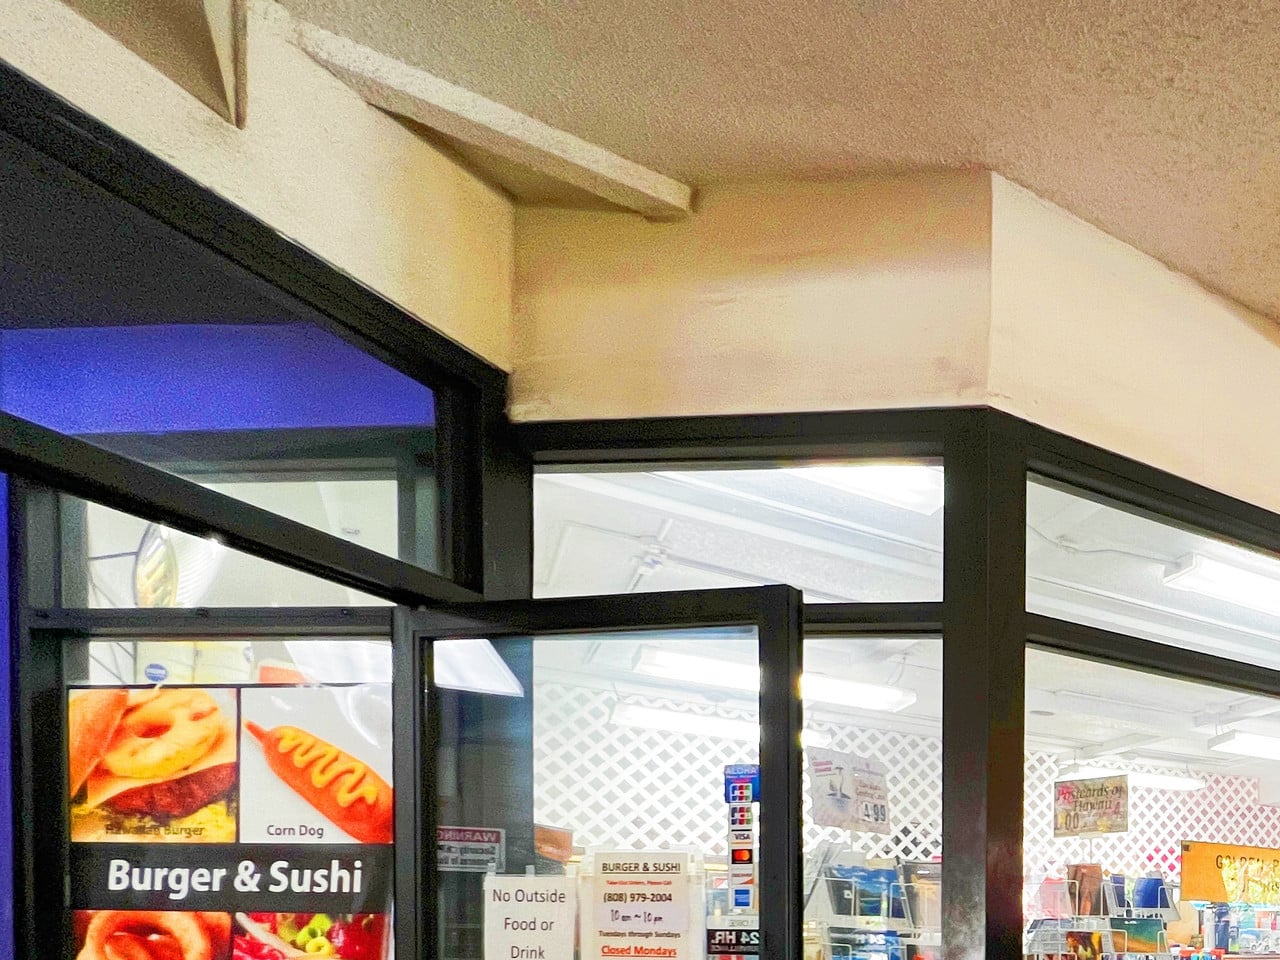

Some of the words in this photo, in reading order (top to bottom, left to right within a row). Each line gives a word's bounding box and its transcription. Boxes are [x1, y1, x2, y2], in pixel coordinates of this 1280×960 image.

[163, 824, 206, 838] Burger
[267, 824, 297, 836] Corn
[299, 825, 325, 838] Dog
[733, 833, 751, 841] VISA
[601, 862, 640, 873] BURGER
[642, 862, 650, 872] &
[652, 862, 681, 873] SUSHI
[107, 859, 227, 900] Burger
[233, 860, 262, 893] &
[268, 859, 363, 893] Sushi
[492, 889, 512, 903] No
[514, 888, 566, 903] Outside
[603, 892, 628, 904] (808)
[630, 893, 673, 903] 979-2004
[610, 909, 620, 922] 10
[503, 917, 536, 931] Food
[539, 919, 555, 931] or
[510, 945, 546, 960] Drink
[601, 945, 632, 956] Closed
[634, 945, 677, 957] Mondays
